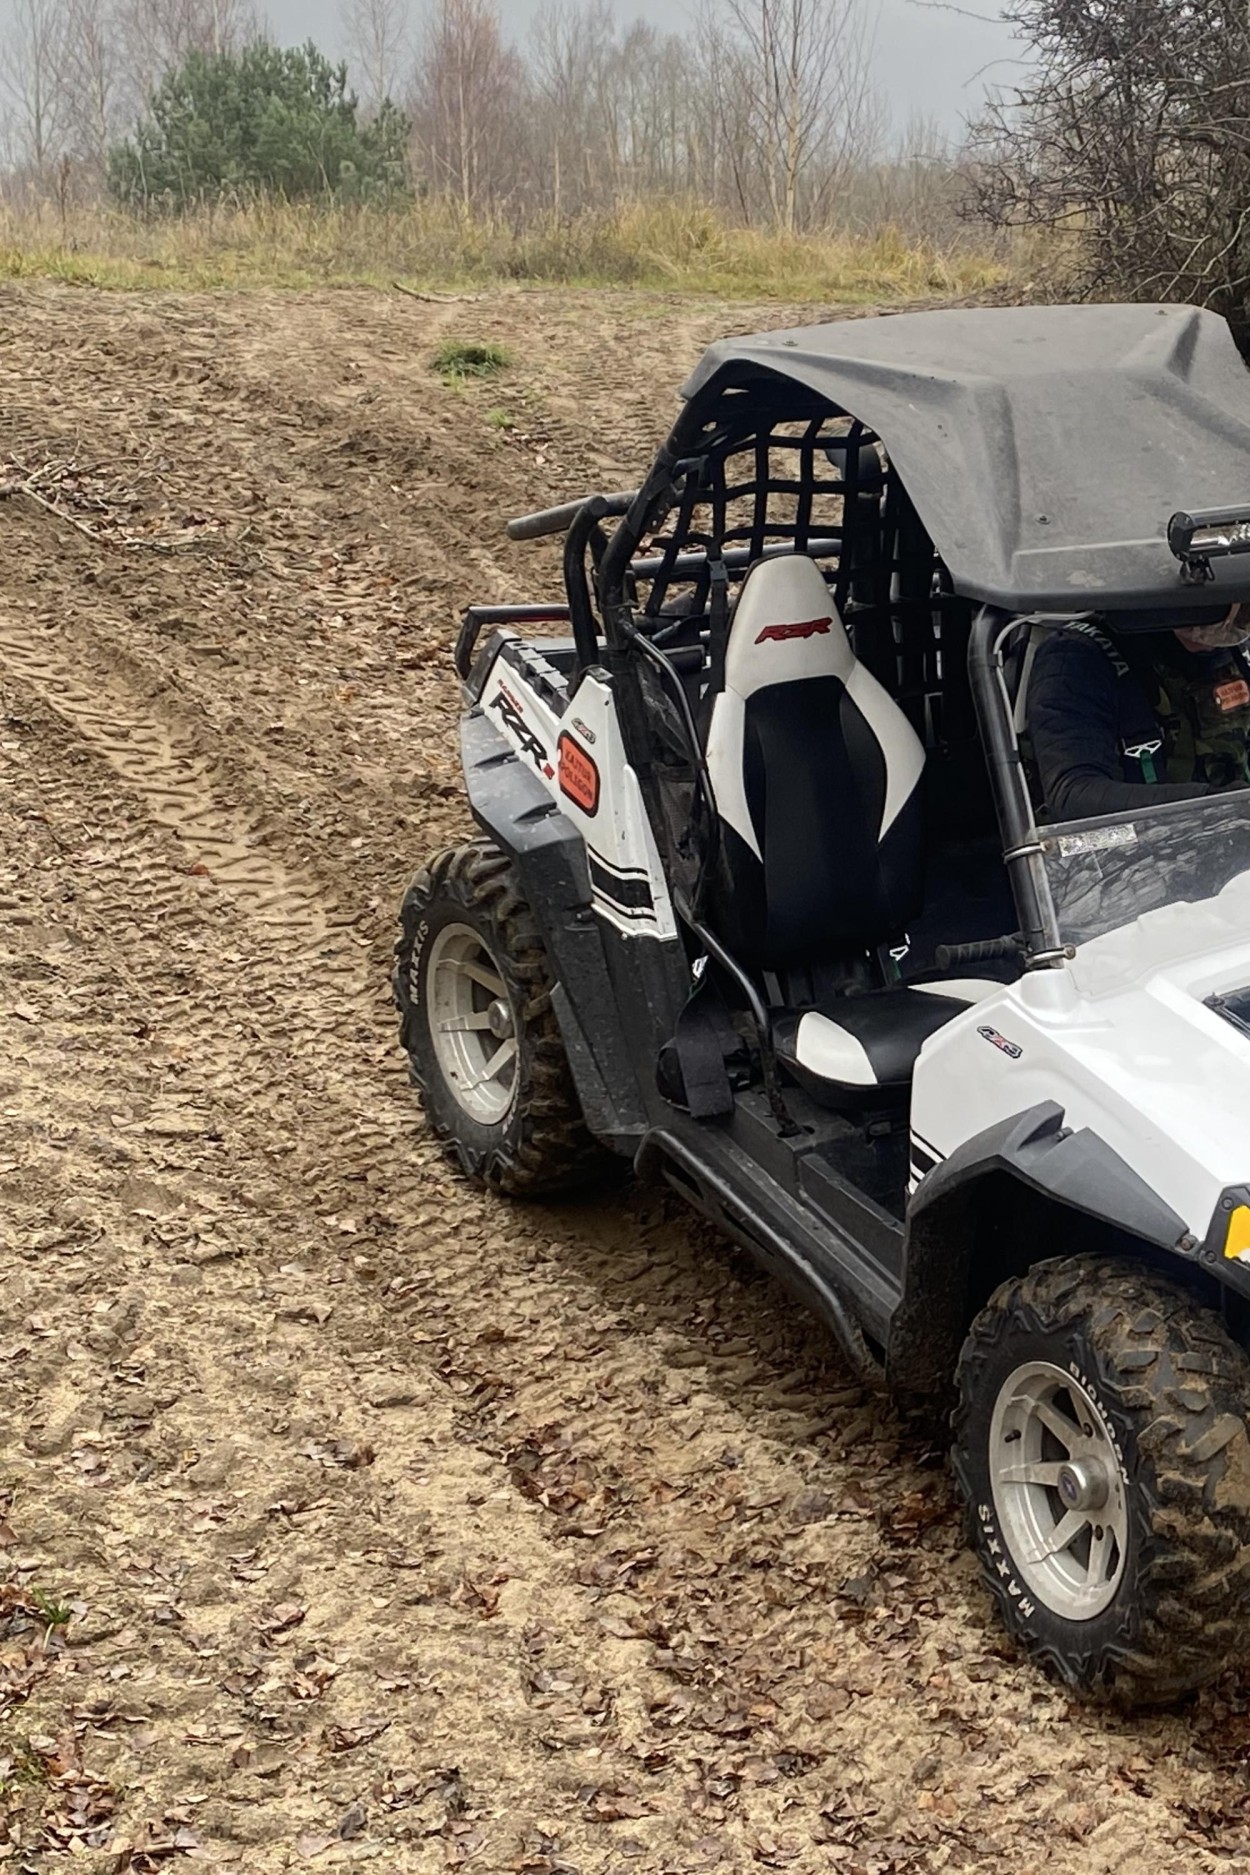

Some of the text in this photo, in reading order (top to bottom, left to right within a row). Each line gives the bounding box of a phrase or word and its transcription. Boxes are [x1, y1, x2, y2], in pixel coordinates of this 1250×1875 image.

[488, 690, 549, 772] RZR
[409, 919, 429, 1006] MAXXIS
[978, 1504, 1036, 1618] MAXXIS
